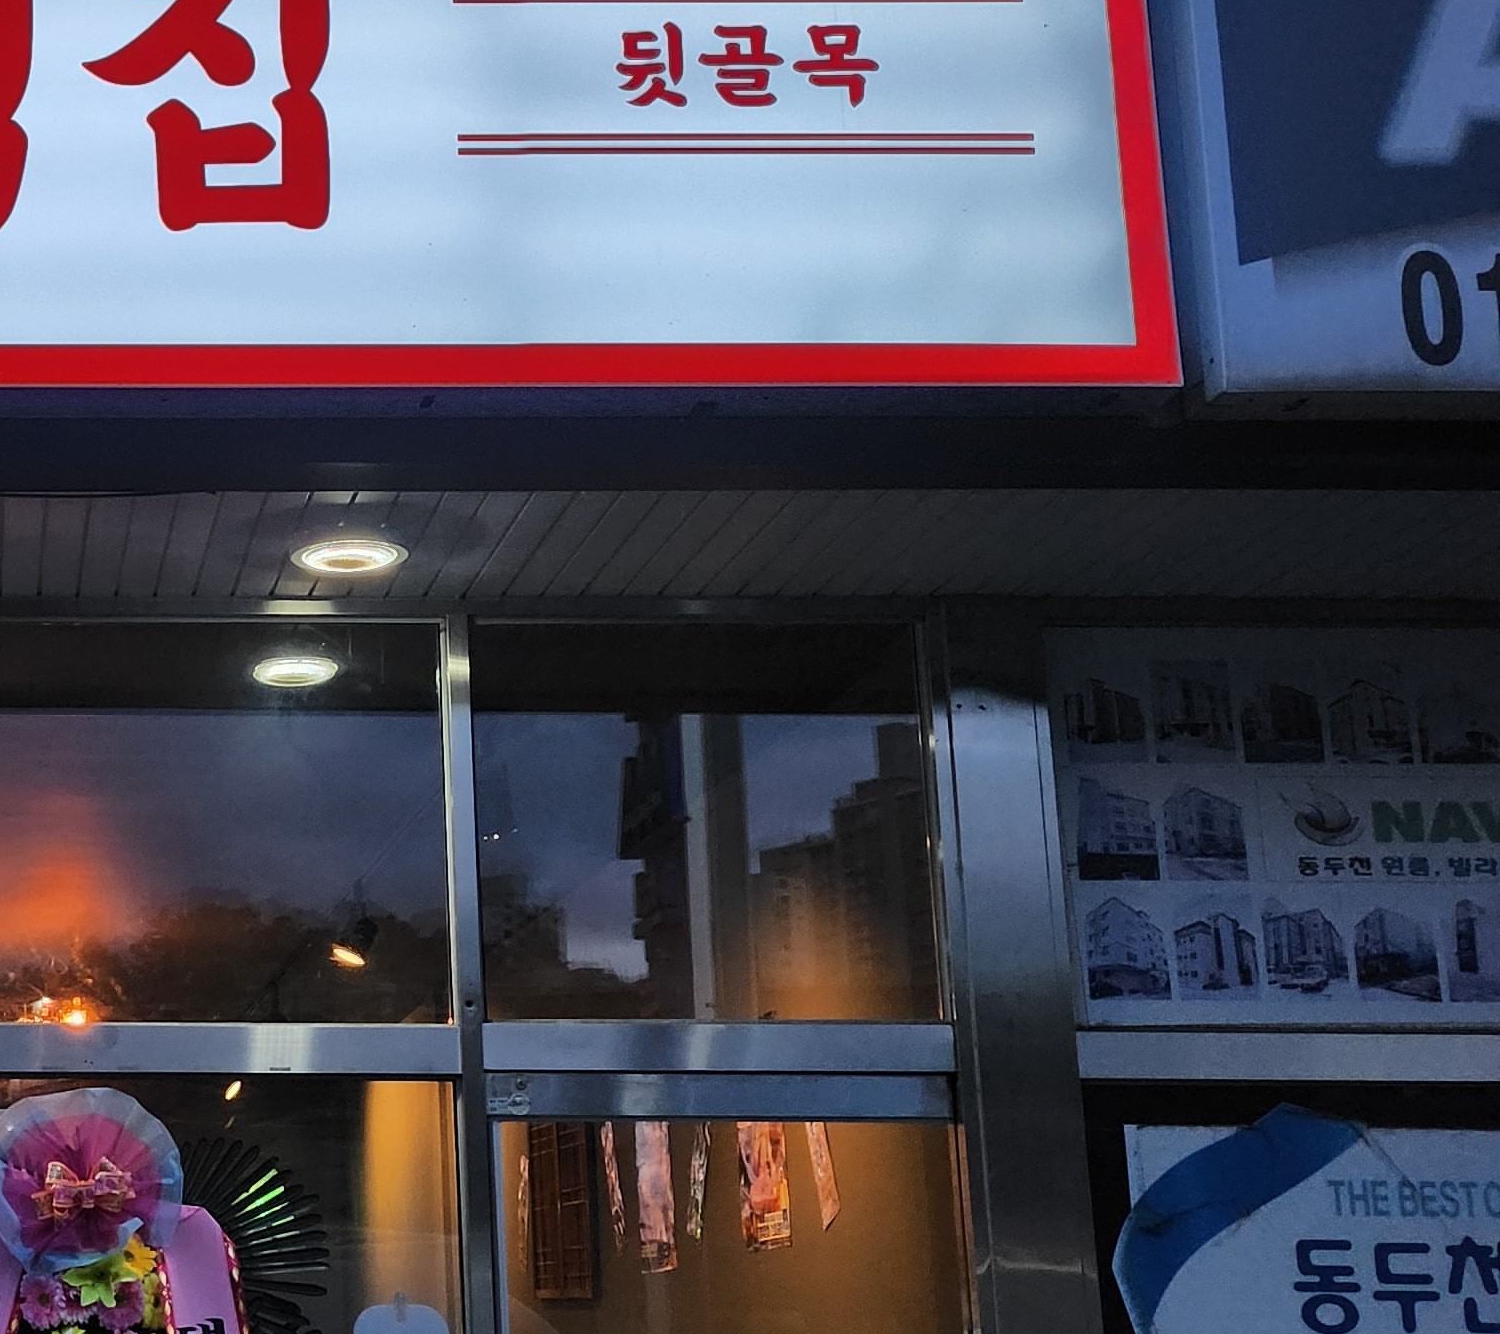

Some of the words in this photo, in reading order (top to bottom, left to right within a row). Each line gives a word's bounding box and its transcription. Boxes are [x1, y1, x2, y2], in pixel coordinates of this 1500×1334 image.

[614, 20, 880, 108] 뒷골목
[1326, 1179, 1391, 1218] THE
[1398, 1179, 1477, 1219] BEST
